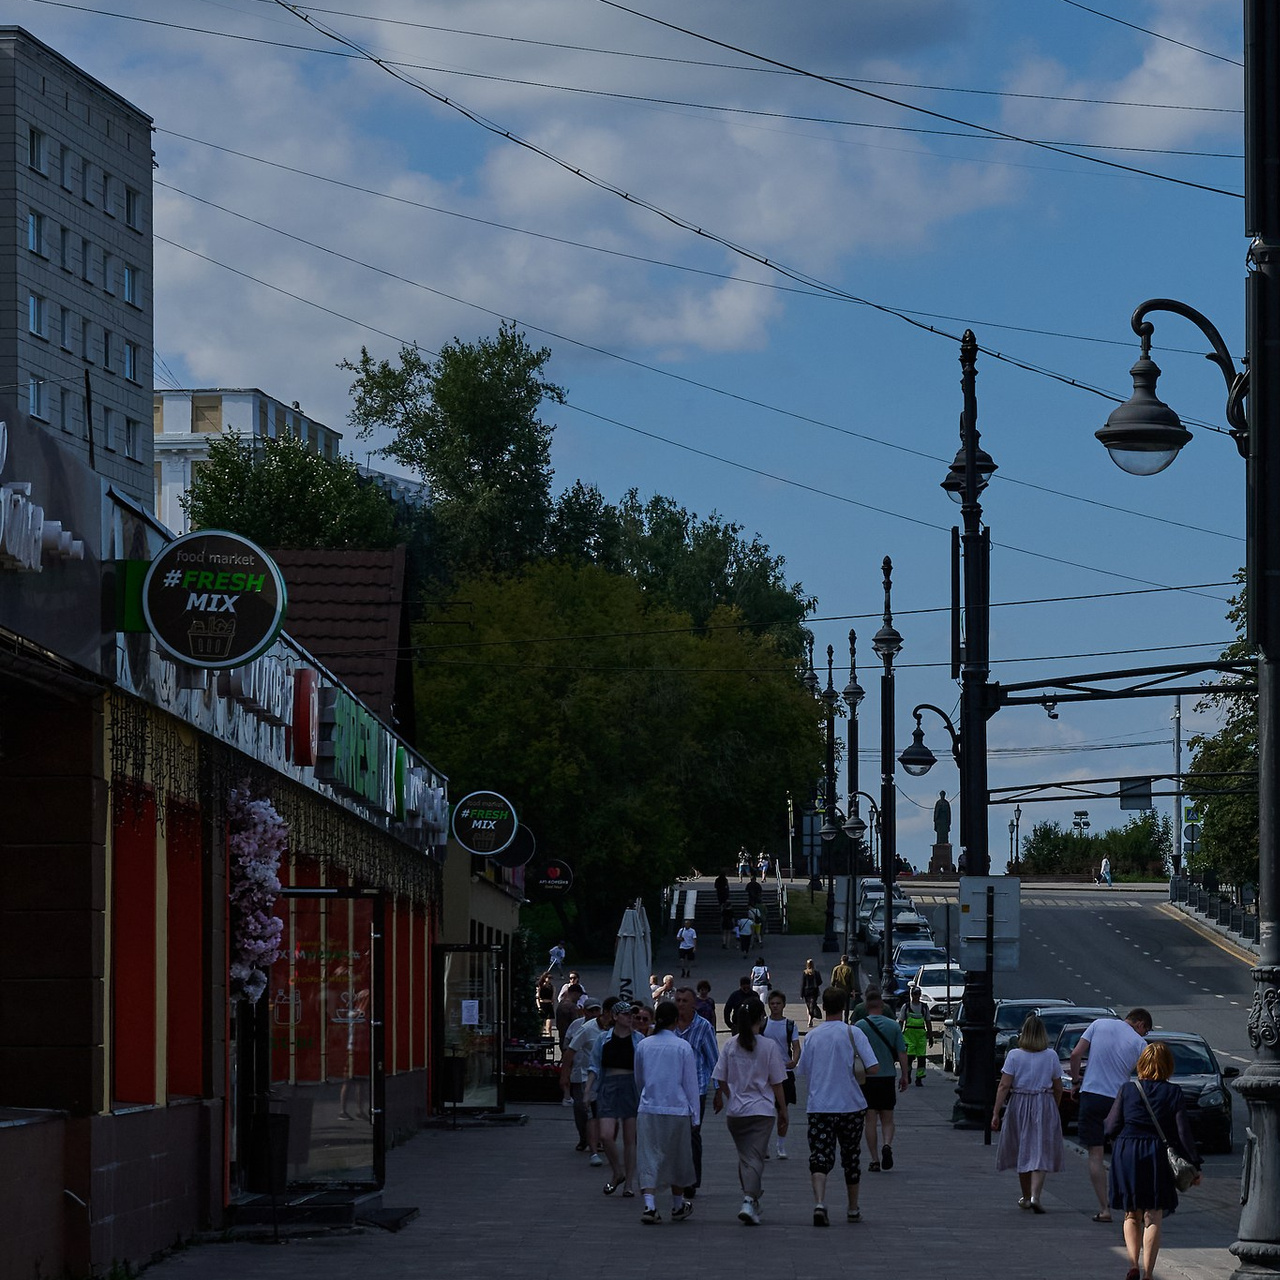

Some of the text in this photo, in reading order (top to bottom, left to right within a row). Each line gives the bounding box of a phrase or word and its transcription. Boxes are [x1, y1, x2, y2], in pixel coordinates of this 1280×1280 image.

[176, 550, 255, 566] food market
[162, 569, 266, 592] #FRESH
[186, 592, 241, 613] MIX
[461, 809, 509, 820] #FRESH
[471, 820, 497, 830] MIX
